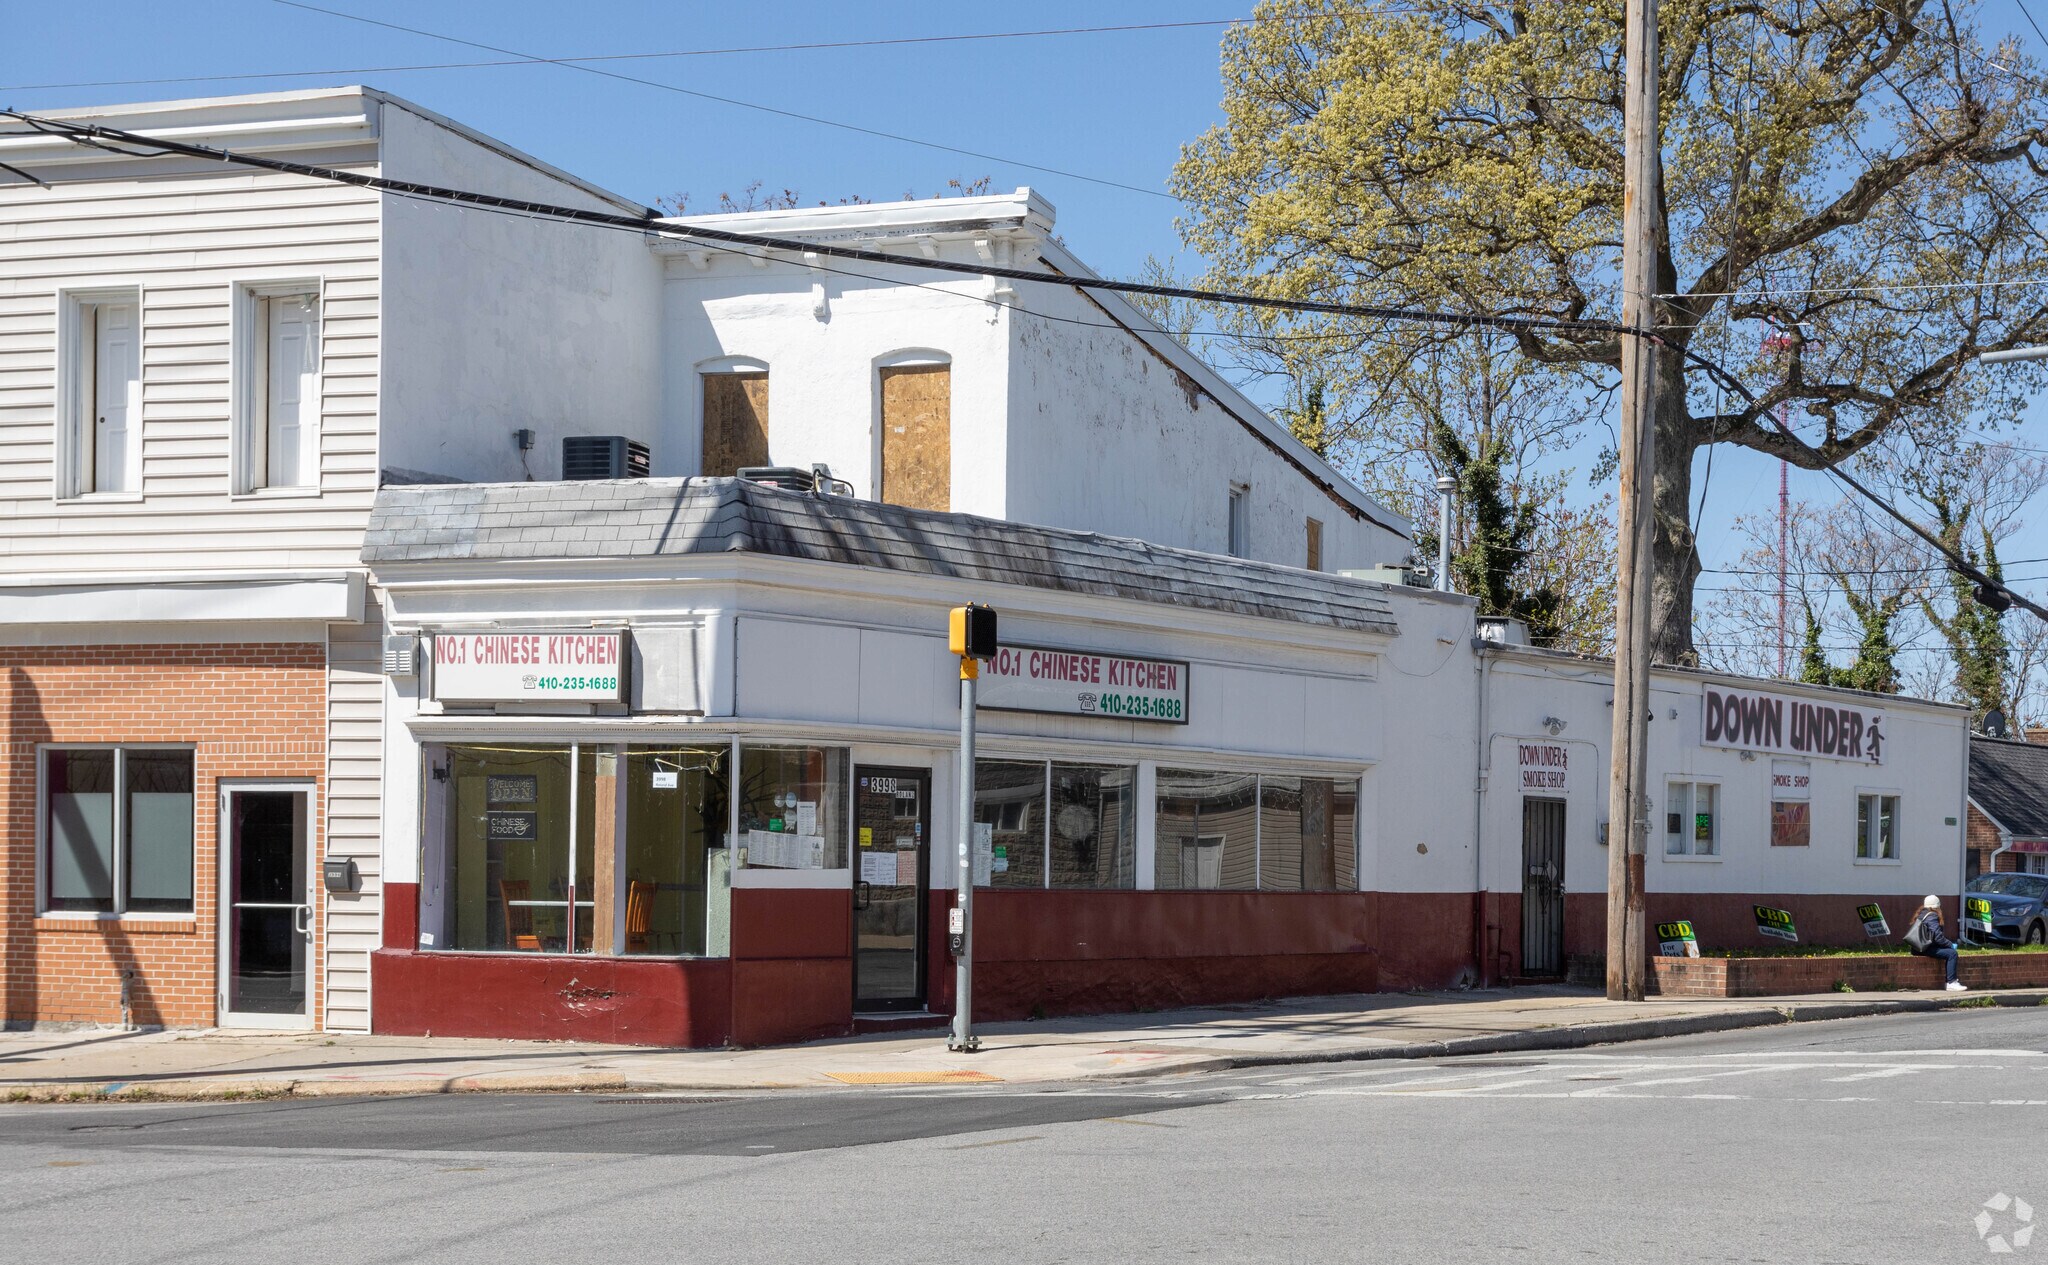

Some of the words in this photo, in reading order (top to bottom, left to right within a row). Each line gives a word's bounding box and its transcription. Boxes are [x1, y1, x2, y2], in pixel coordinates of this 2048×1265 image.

[436, 635, 466, 665] NO.1
[474, 635, 540, 665] CHINESE
[548, 635, 617, 665] KITCHEN
[987, 648, 1021, 677] NO.1
[1029, 651, 1101, 684] CHINESE
[1108, 659, 1178, 691] KITCHEN
[538, 676, 617, 690] 410-235-1688
[1100, 692, 1181, 719] 410-235-1688
[1705, 690, 1783, 748] DOWN
[1789, 701, 1864, 758] UNDER
[1519, 744, 1540, 766] DOWN
[1541, 745, 1562, 768] UNDER
[491, 779, 531, 789] WELCOME
[872, 777, 896, 793] 3998
[1522, 770, 1547, 788] SMOKE
[1547, 771, 1566, 788] SHOP
[1794, 775, 1809, 788] SHOP
[492, 787, 532, 799] OPEN
[491, 817, 526, 826] CHINESE
[491, 826, 514, 834] FOOD
[1859, 904, 1880, 919] CBD
[1967, 898, 1990, 913] CBD
[1756, 906, 1789, 923] CBD
[1658, 923, 1690, 938] CBD
[1662, 943, 1675, 951] For
